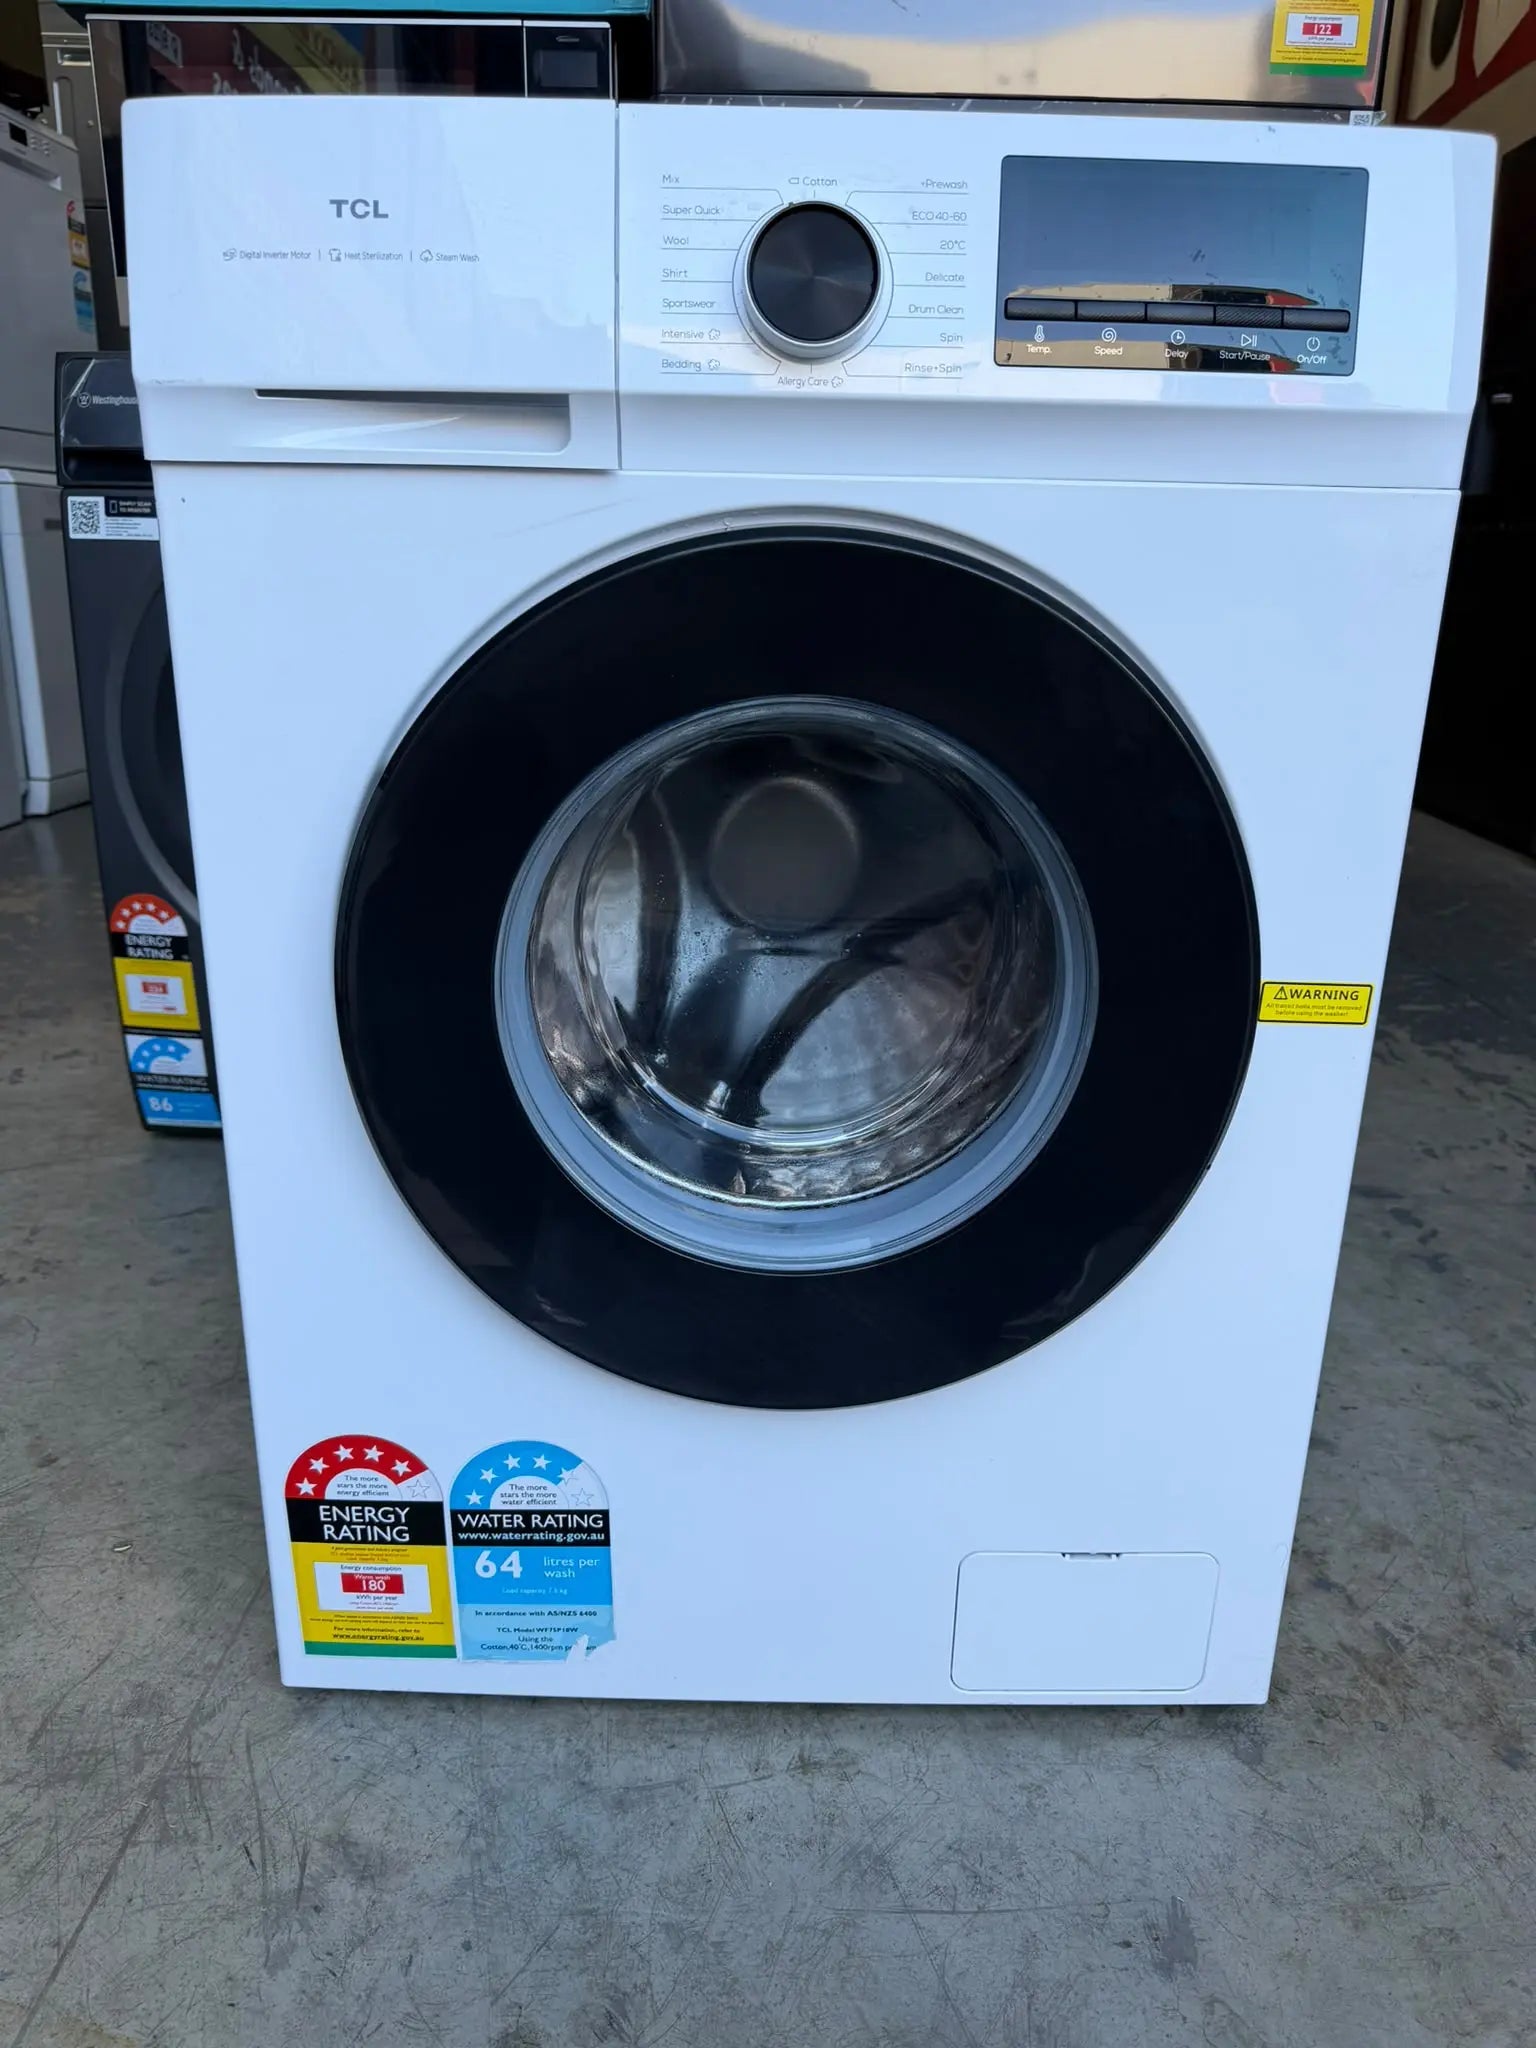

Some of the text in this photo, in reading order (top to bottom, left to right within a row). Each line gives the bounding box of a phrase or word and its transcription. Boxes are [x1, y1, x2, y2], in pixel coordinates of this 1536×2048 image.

[1314, 24, 1332, 34] 122
[662, 174, 679, 183] Mix
[803, 177, 837, 186] Cotton
[921, 180, 968, 189] +Prewash
[329, 199, 389, 219] TCL
[662, 205, 720, 215] Super Quick
[663, 236, 689, 245] Wool
[940, 240, 966, 250] 20°C
[240, 251, 311, 259] Digital Inverter Motor
[362, 252, 403, 261] Sterilization
[436, 253, 479, 262] Steam Wash
[662, 268, 687, 278] Shirt
[925, 272, 965, 282] Delicate
[662, 299, 716, 310] Sportswear
[909, 305, 964, 315] Drum Clean
[662, 329, 704, 339] Intensive
[940, 333, 963, 343] Spin
[1027, 344, 1052, 355] Temp.
[1094, 345, 1123, 356] Speed
[1165, 348, 1189, 359] Delay
[1220, 350, 1270, 362] Start/Pause
[1297, 354, 1326, 365] On/Off
[662, 359, 701, 371] Bedding
[904, 362, 962, 373] Rinse+Spin
[778, 376, 829, 388] Allergy Care
[92, 396, 138, 406] Westinghous
[125, 934, 172, 947] ENERGY
[127, 947, 174, 960] RATING
[1290, 989, 1359, 1000] WARNING
[148, 1097, 174, 1112] 86
[319, 1505, 410, 1523] ENERGY
[457, 1514, 603, 1528] WATER RATING
[323, 1525, 410, 1542] RATING
[458, 1532, 604, 1542] www.waterrating.gov.au
[475, 1550, 523, 1578] 64
[543, 1557, 600, 1569] litres per
[544, 1569, 575, 1578] wash
[362, 1580, 386, 1591] 180
